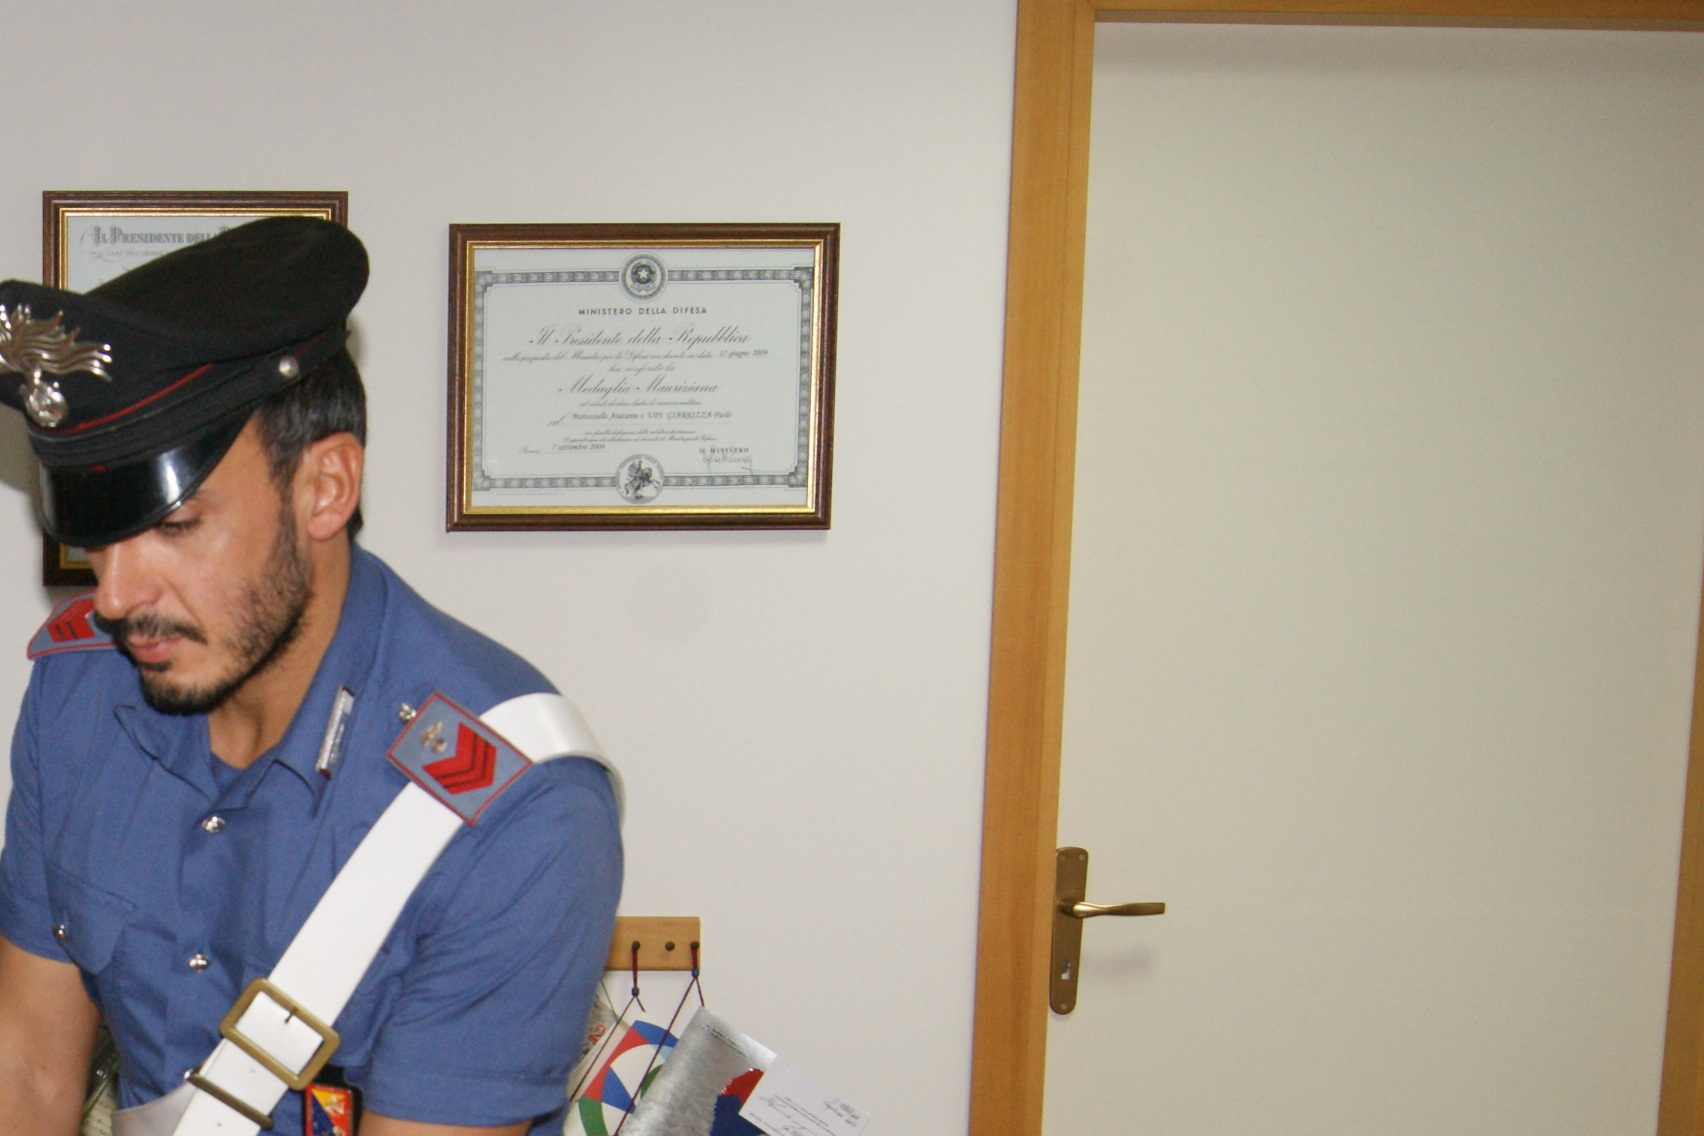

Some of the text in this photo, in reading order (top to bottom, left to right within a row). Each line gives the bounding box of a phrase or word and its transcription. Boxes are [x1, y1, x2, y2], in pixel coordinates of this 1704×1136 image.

[110, 226, 184, 245] PRESIDENTE
[185, 232, 217, 243] DELL
[639, 307, 666, 315] DELLA
[555, 323, 623, 345] Presidente
[627, 326, 662, 344] della
[669, 322, 749, 350] Repubblica
[558, 374, 719, 399] Medaglia Mauriziana
